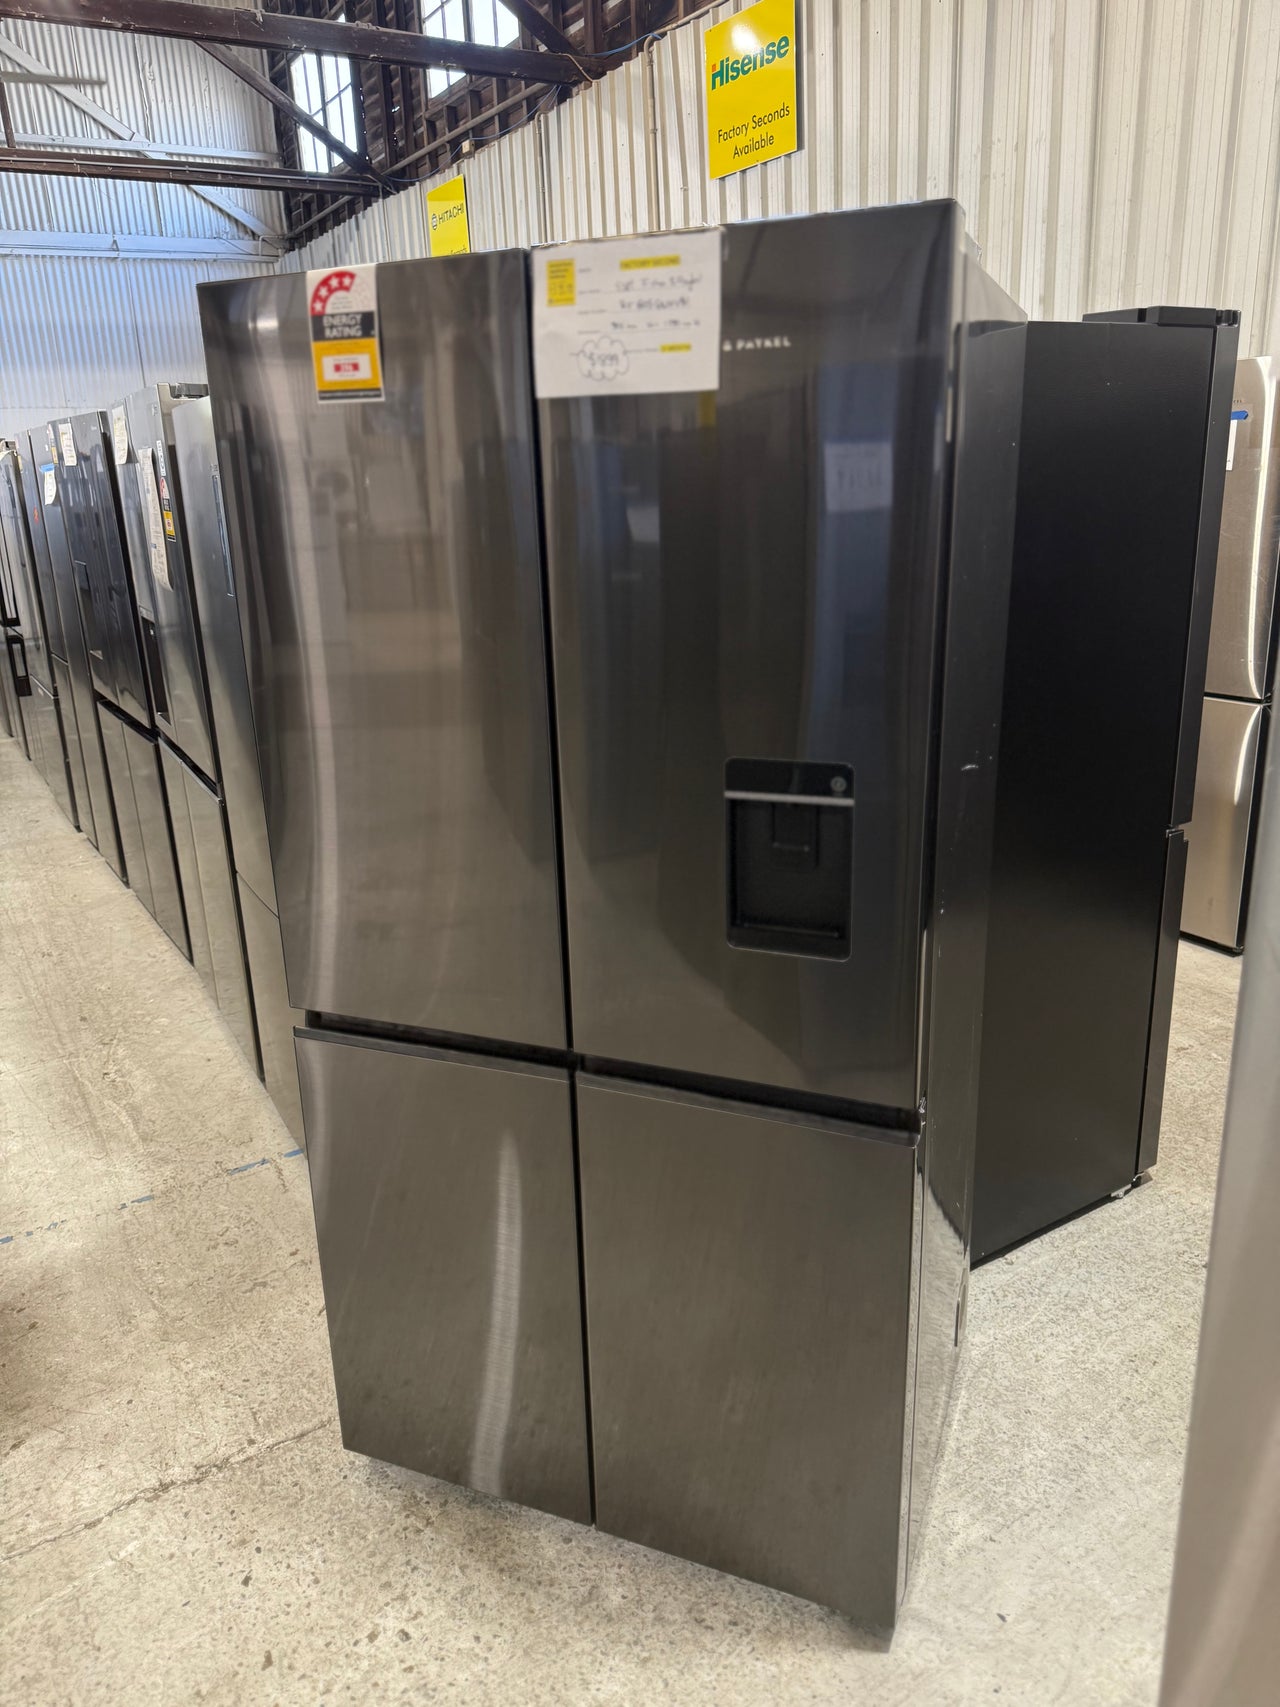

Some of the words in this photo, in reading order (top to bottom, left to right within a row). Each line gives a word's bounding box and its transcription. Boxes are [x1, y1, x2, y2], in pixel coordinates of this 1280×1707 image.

[711, 35, 790, 91] Hisense
[718, 121, 750, 144] Factory
[752, 102, 790, 130] Seconds
[733, 132, 775, 159] Available
[438, 202, 464, 225] HITACHI
[322, 313, 362, 327] ENERGY
[324, 325, 362, 338] RATING
